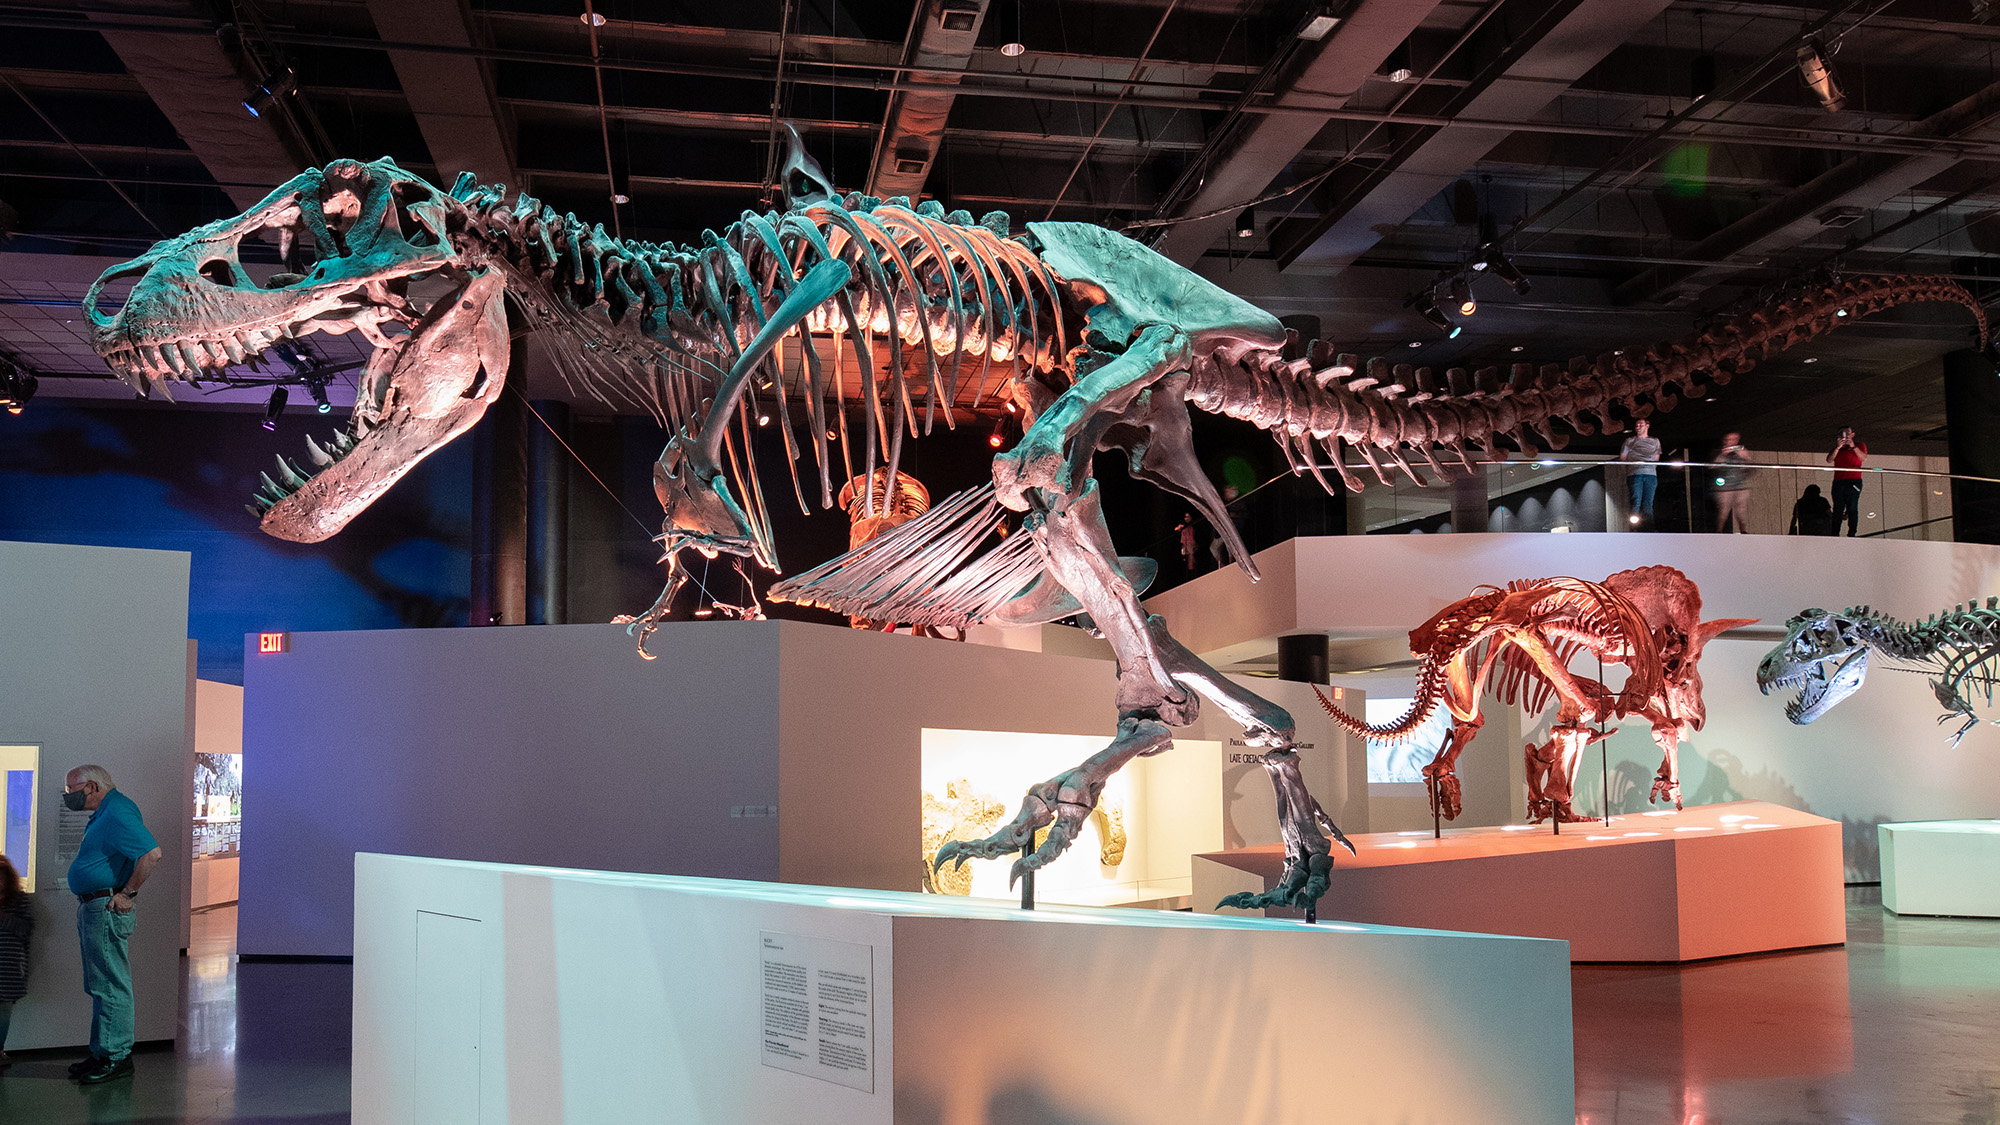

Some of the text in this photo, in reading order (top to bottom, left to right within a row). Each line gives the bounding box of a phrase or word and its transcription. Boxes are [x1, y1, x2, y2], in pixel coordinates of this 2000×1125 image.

[260, 633, 282, 651] EXIT
[1230, 754, 1264, 763] LATE CRETACE
